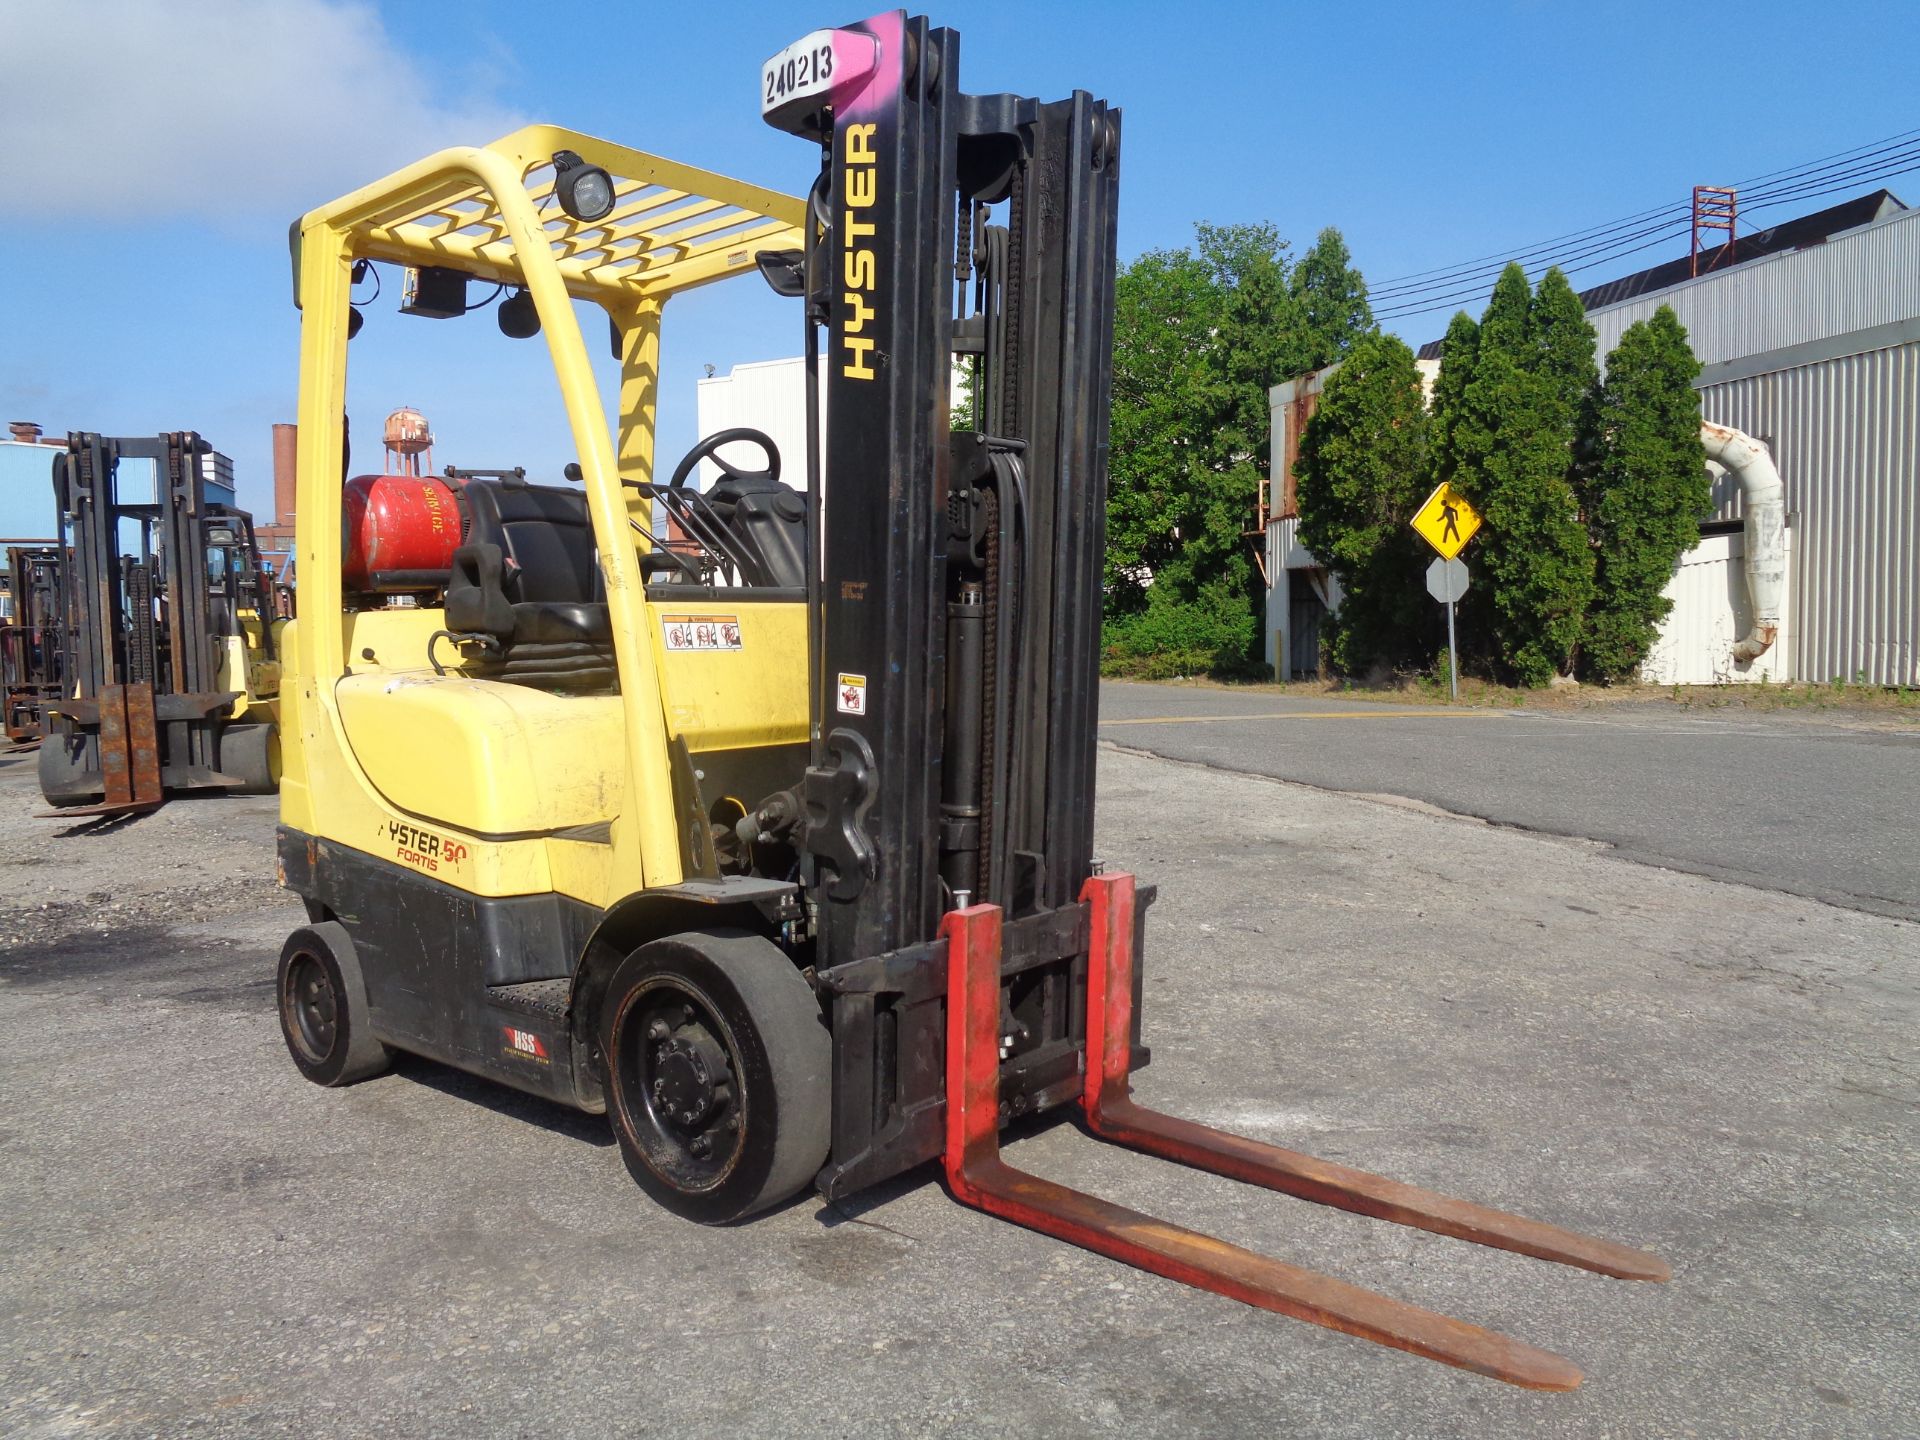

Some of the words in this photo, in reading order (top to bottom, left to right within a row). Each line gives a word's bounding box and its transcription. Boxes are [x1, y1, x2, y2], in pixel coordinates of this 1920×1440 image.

[767, 45, 833, 104] 240213
[843, 123, 877, 380] HYSTER
[378, 821, 440, 857] YSTER
[397, 847, 438, 872] FORTIS
[514, 1029, 536, 1054] HSS
